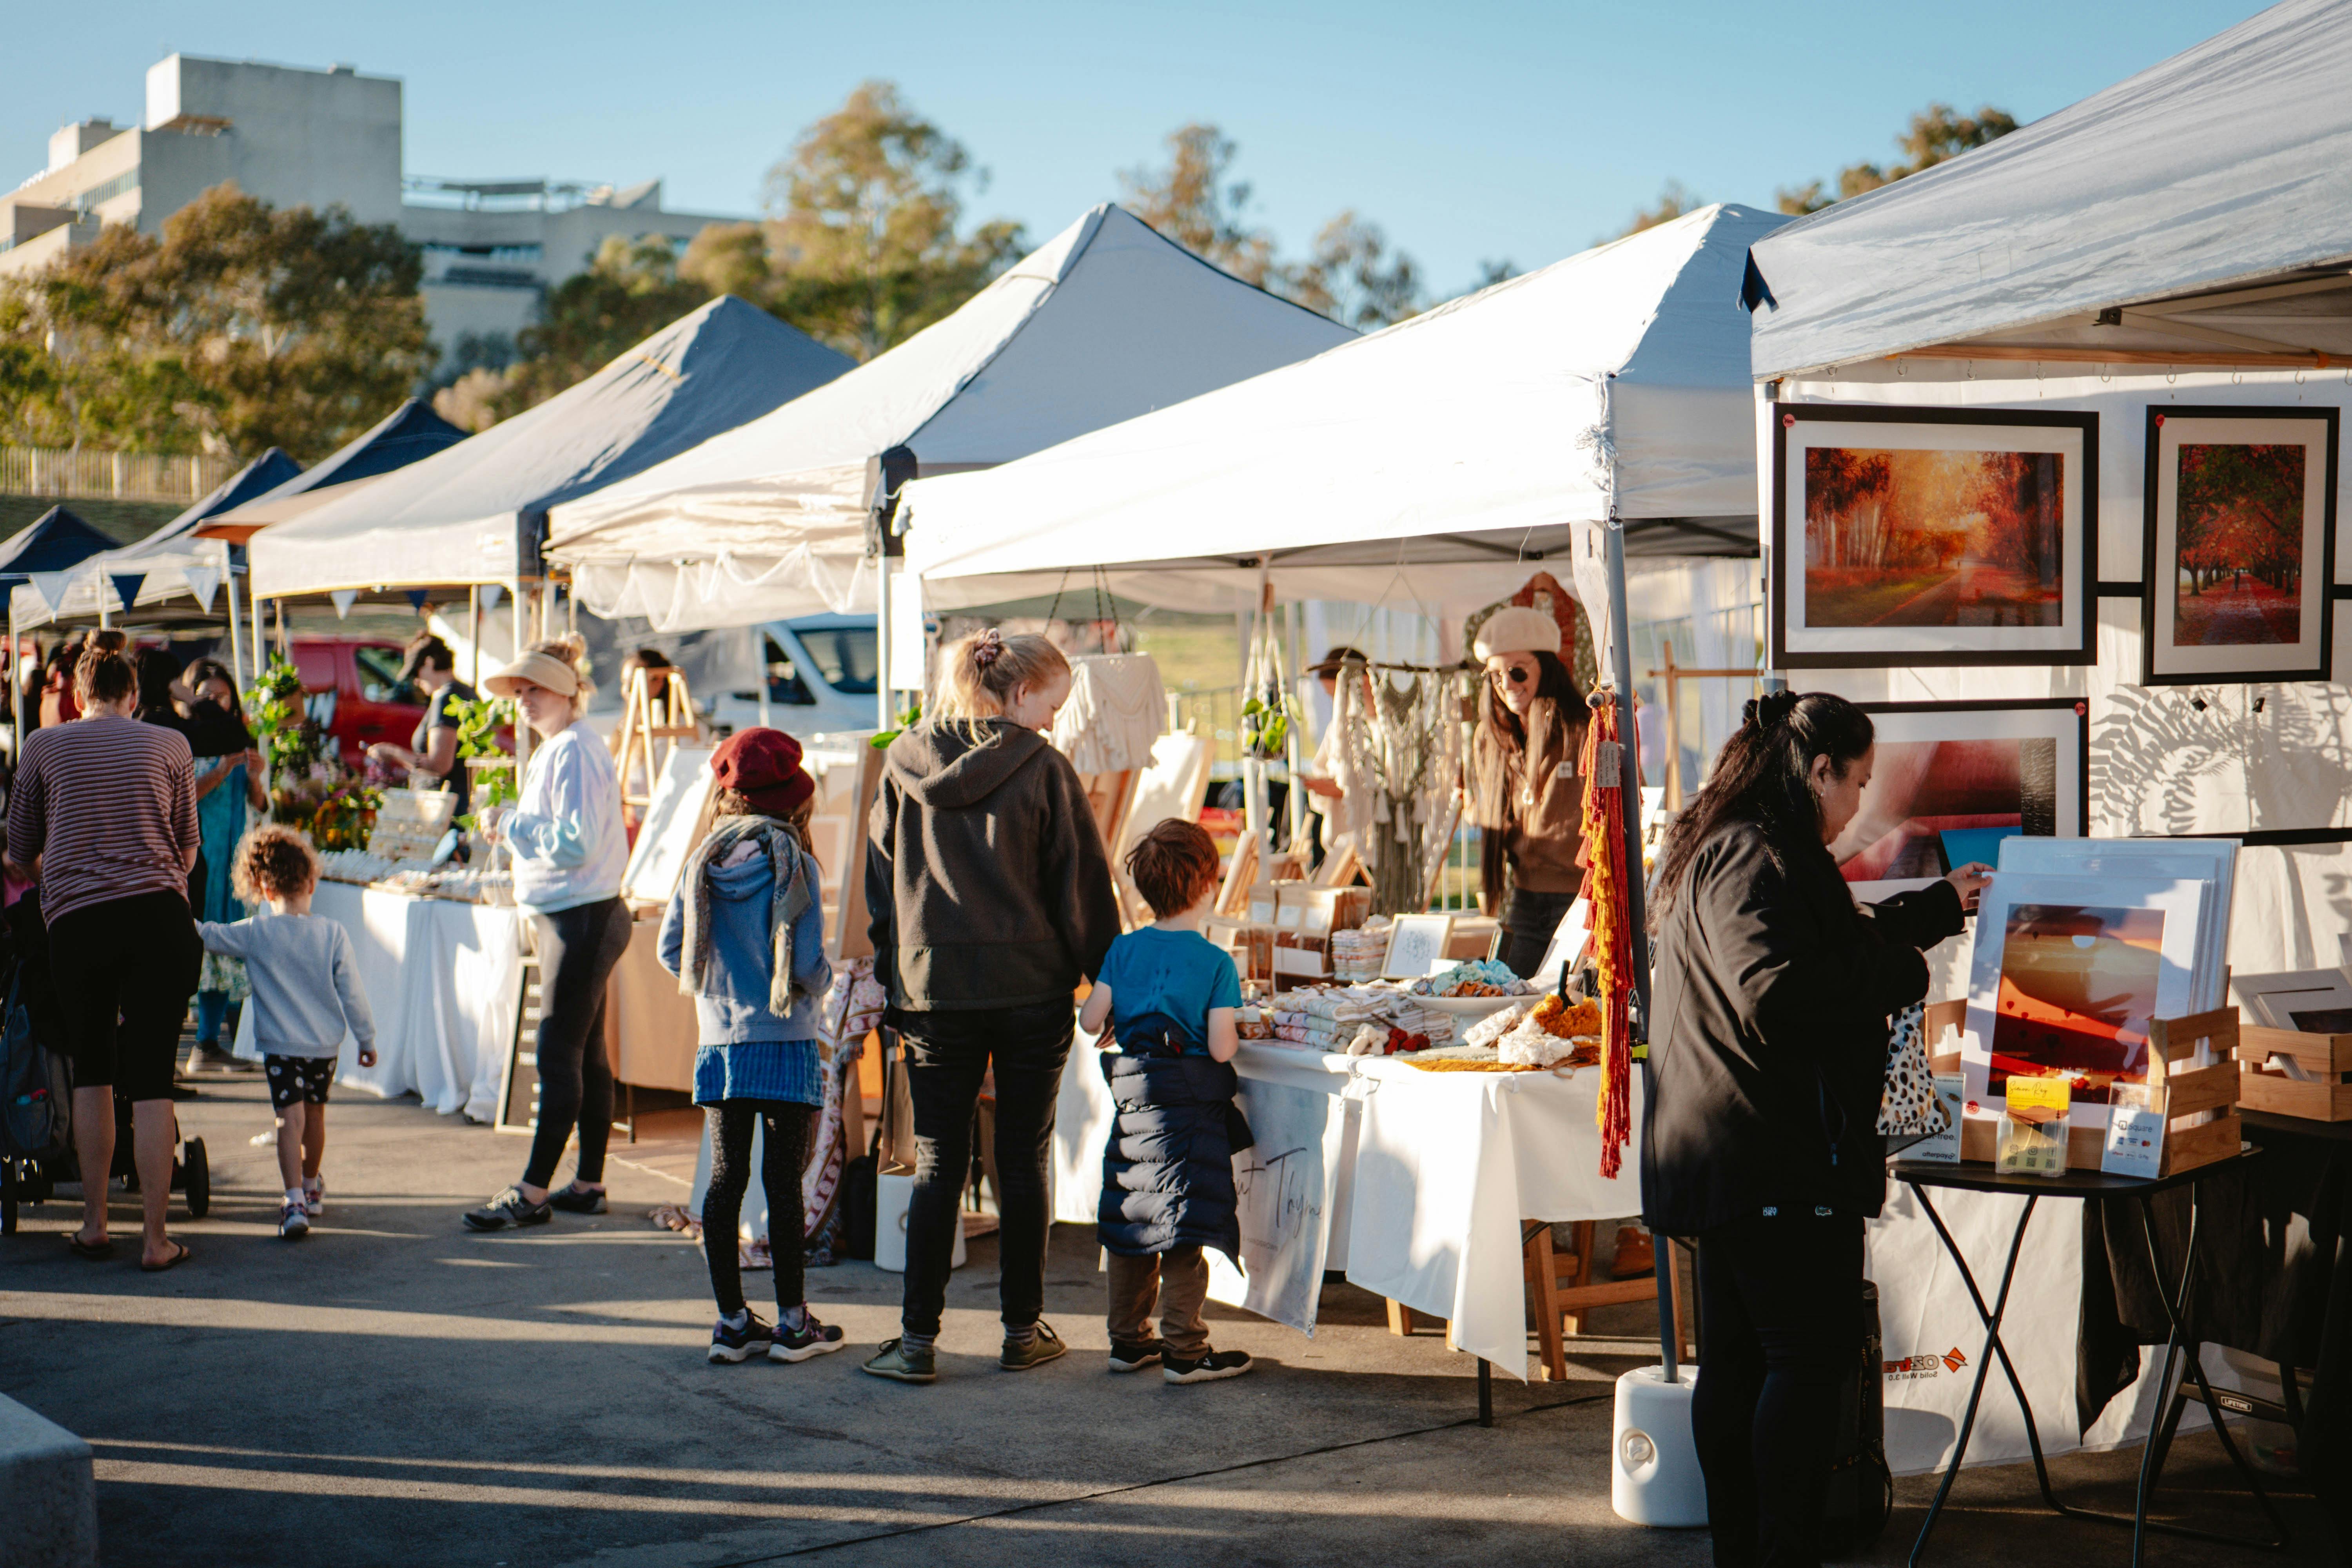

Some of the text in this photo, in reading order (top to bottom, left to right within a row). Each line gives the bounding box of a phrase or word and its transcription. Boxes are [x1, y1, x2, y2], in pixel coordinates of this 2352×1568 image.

[2008, 1080, 2029, 1095] Simon
[2129, 1123, 2152, 1132] Square
[1922, 1151, 1948, 1159] afterpay
[2225, 1398, 2249, 1410] LIFETIME
